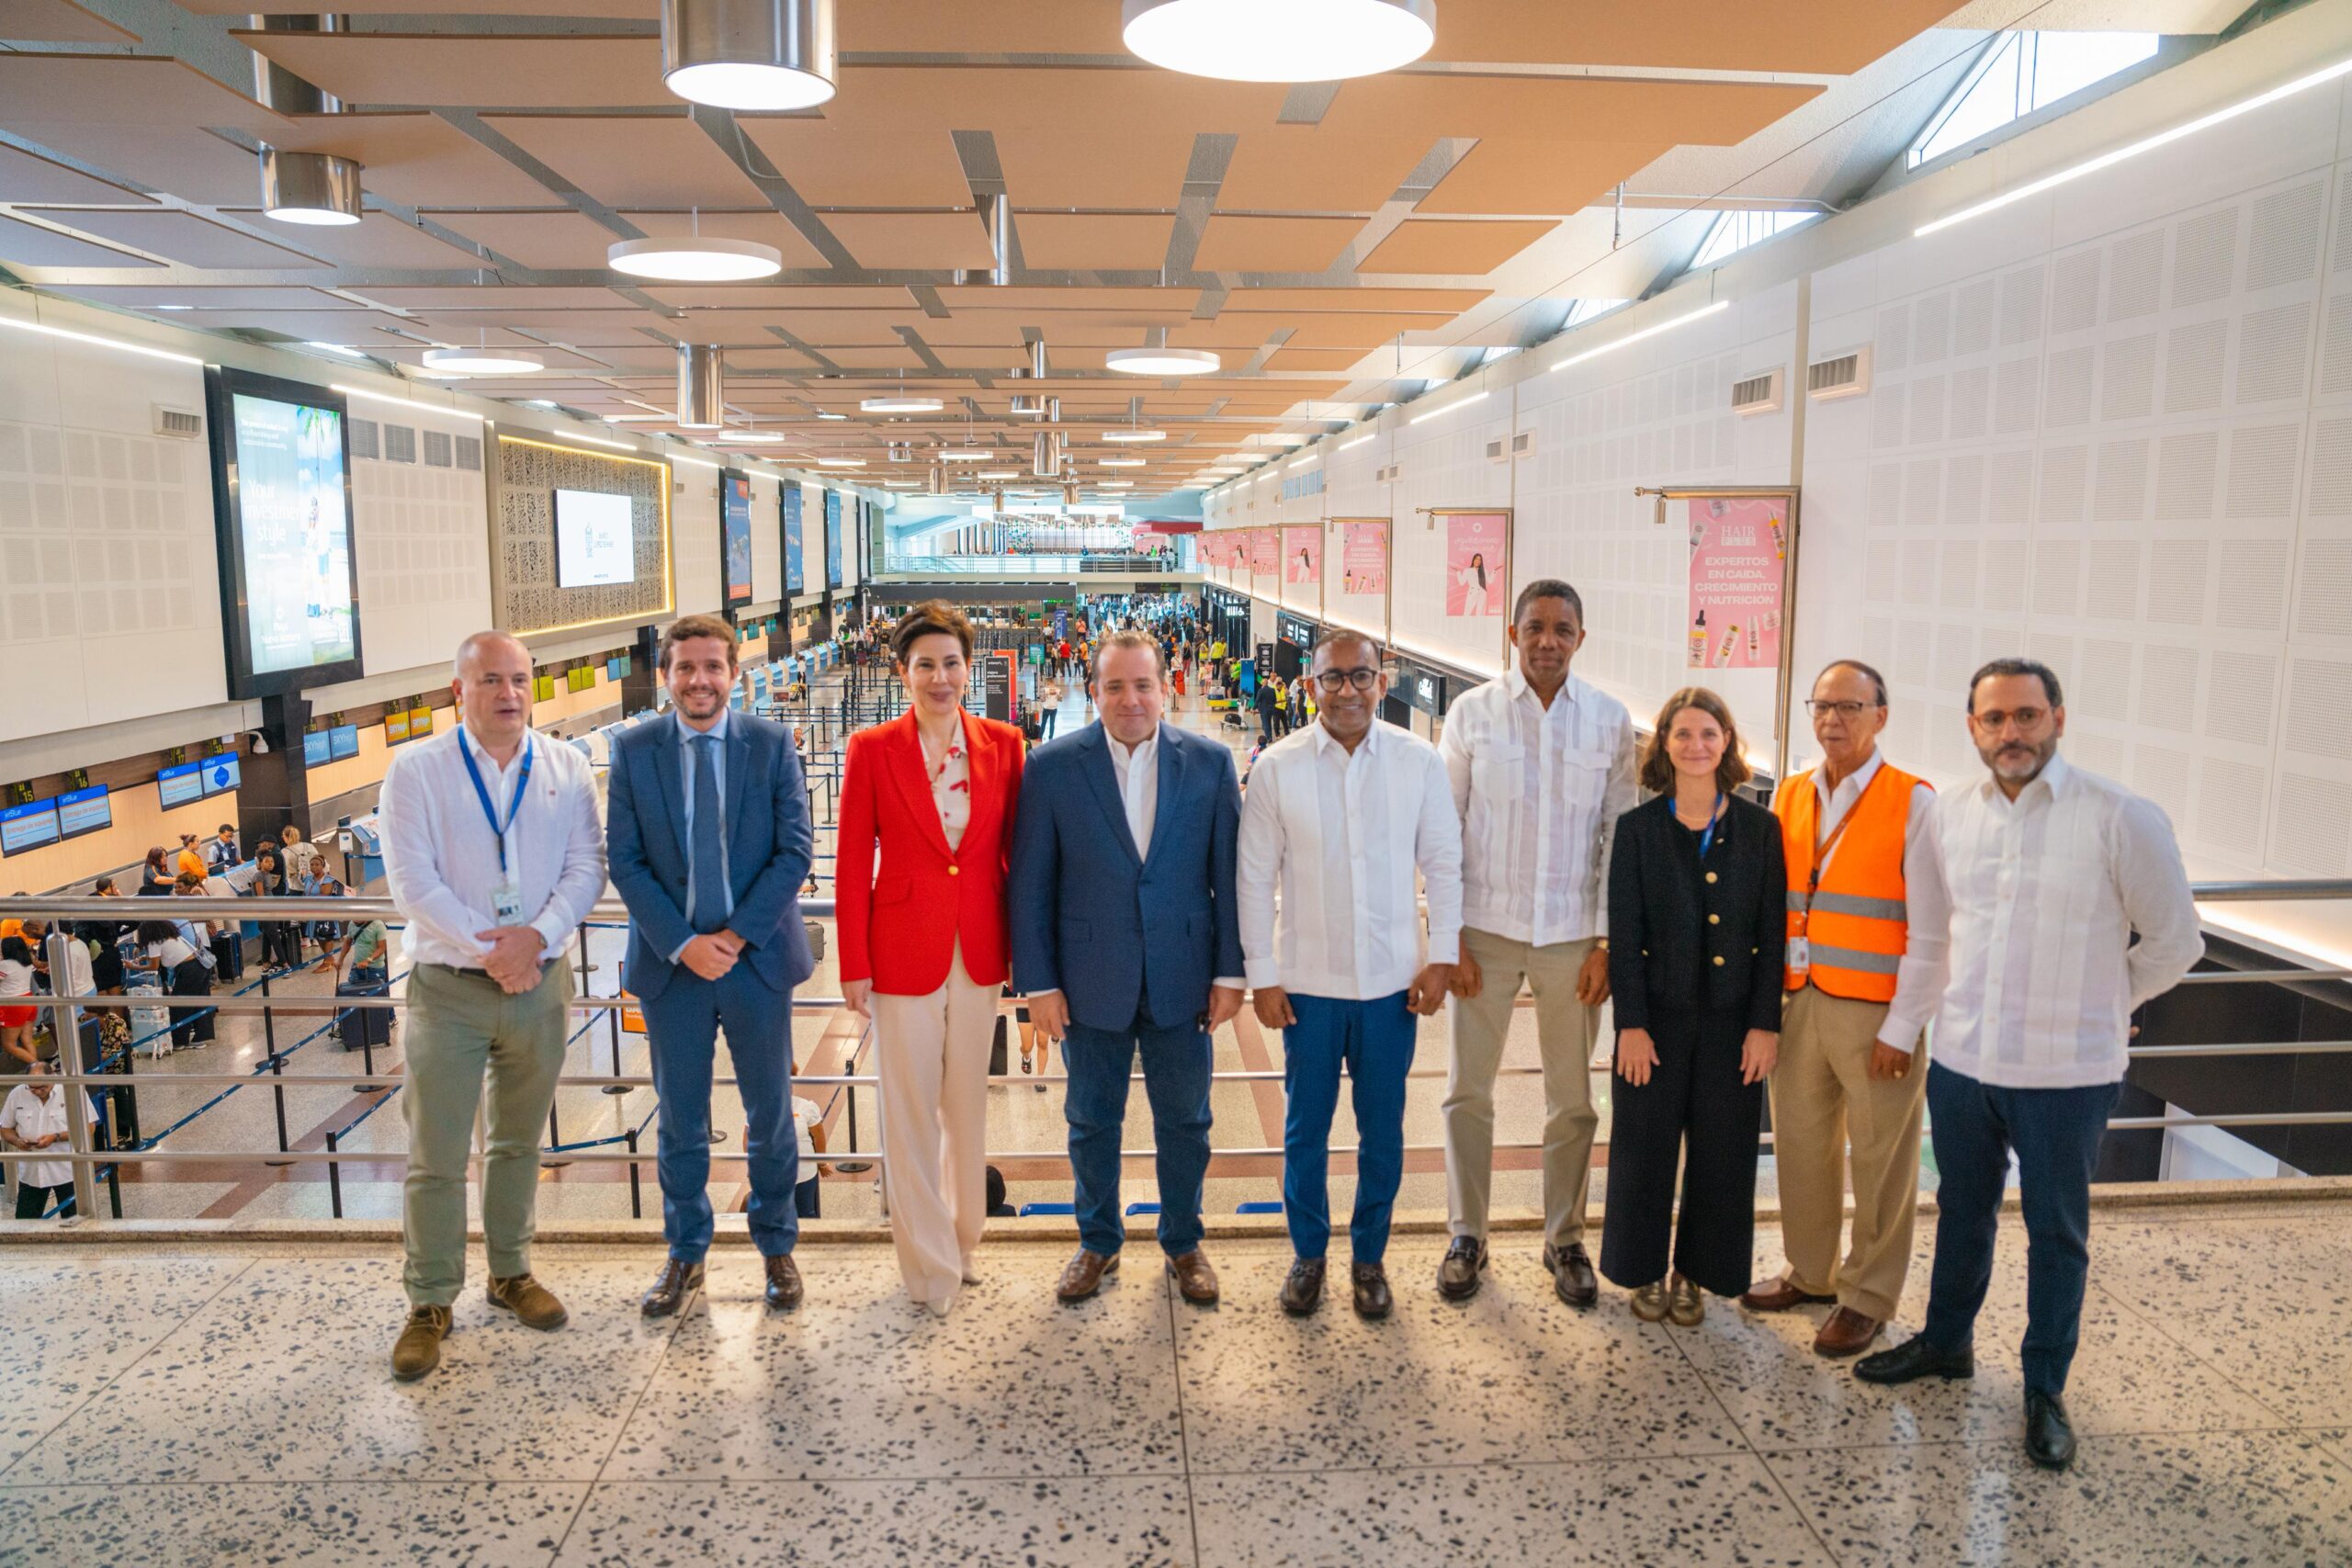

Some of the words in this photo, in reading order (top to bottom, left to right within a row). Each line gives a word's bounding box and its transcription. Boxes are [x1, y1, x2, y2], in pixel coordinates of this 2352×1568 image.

[248, 479, 276, 499] Your
[243, 500, 302, 521] investmen
[256, 521, 287, 546] style
[1722, 525, 1756, 536] HAIR
[1704, 557, 1770, 566] EXPERTOS
[1708, 570, 1724, 579] EN
[1694, 582, 1778, 592] CRECIMIENTO
[1698, 595, 1706, 604] Y
[78, 777, 88, 788] 16
[23, 790, 34, 802] 15
